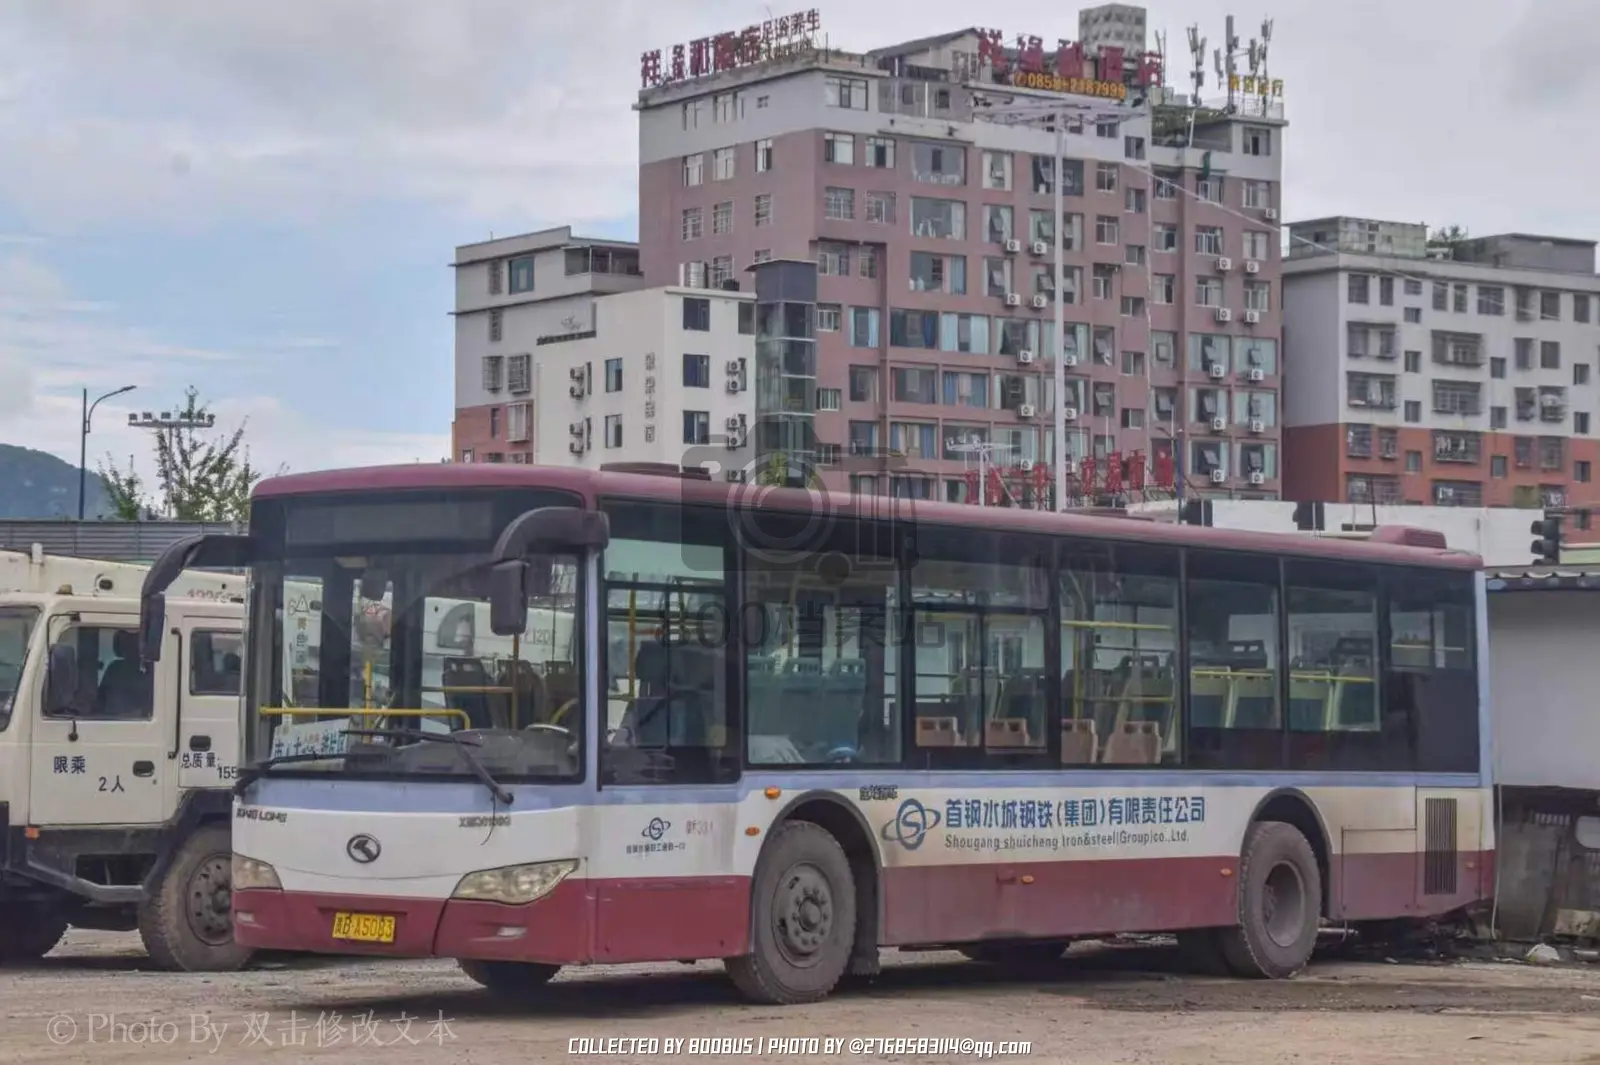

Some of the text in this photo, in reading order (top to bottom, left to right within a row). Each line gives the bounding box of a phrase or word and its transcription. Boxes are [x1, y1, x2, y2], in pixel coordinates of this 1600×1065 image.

[53, 755, 86, 774] 限乘
[945, 834, 1000, 852] Shougang
[1003, 833, 1059, 851] shuicheng
